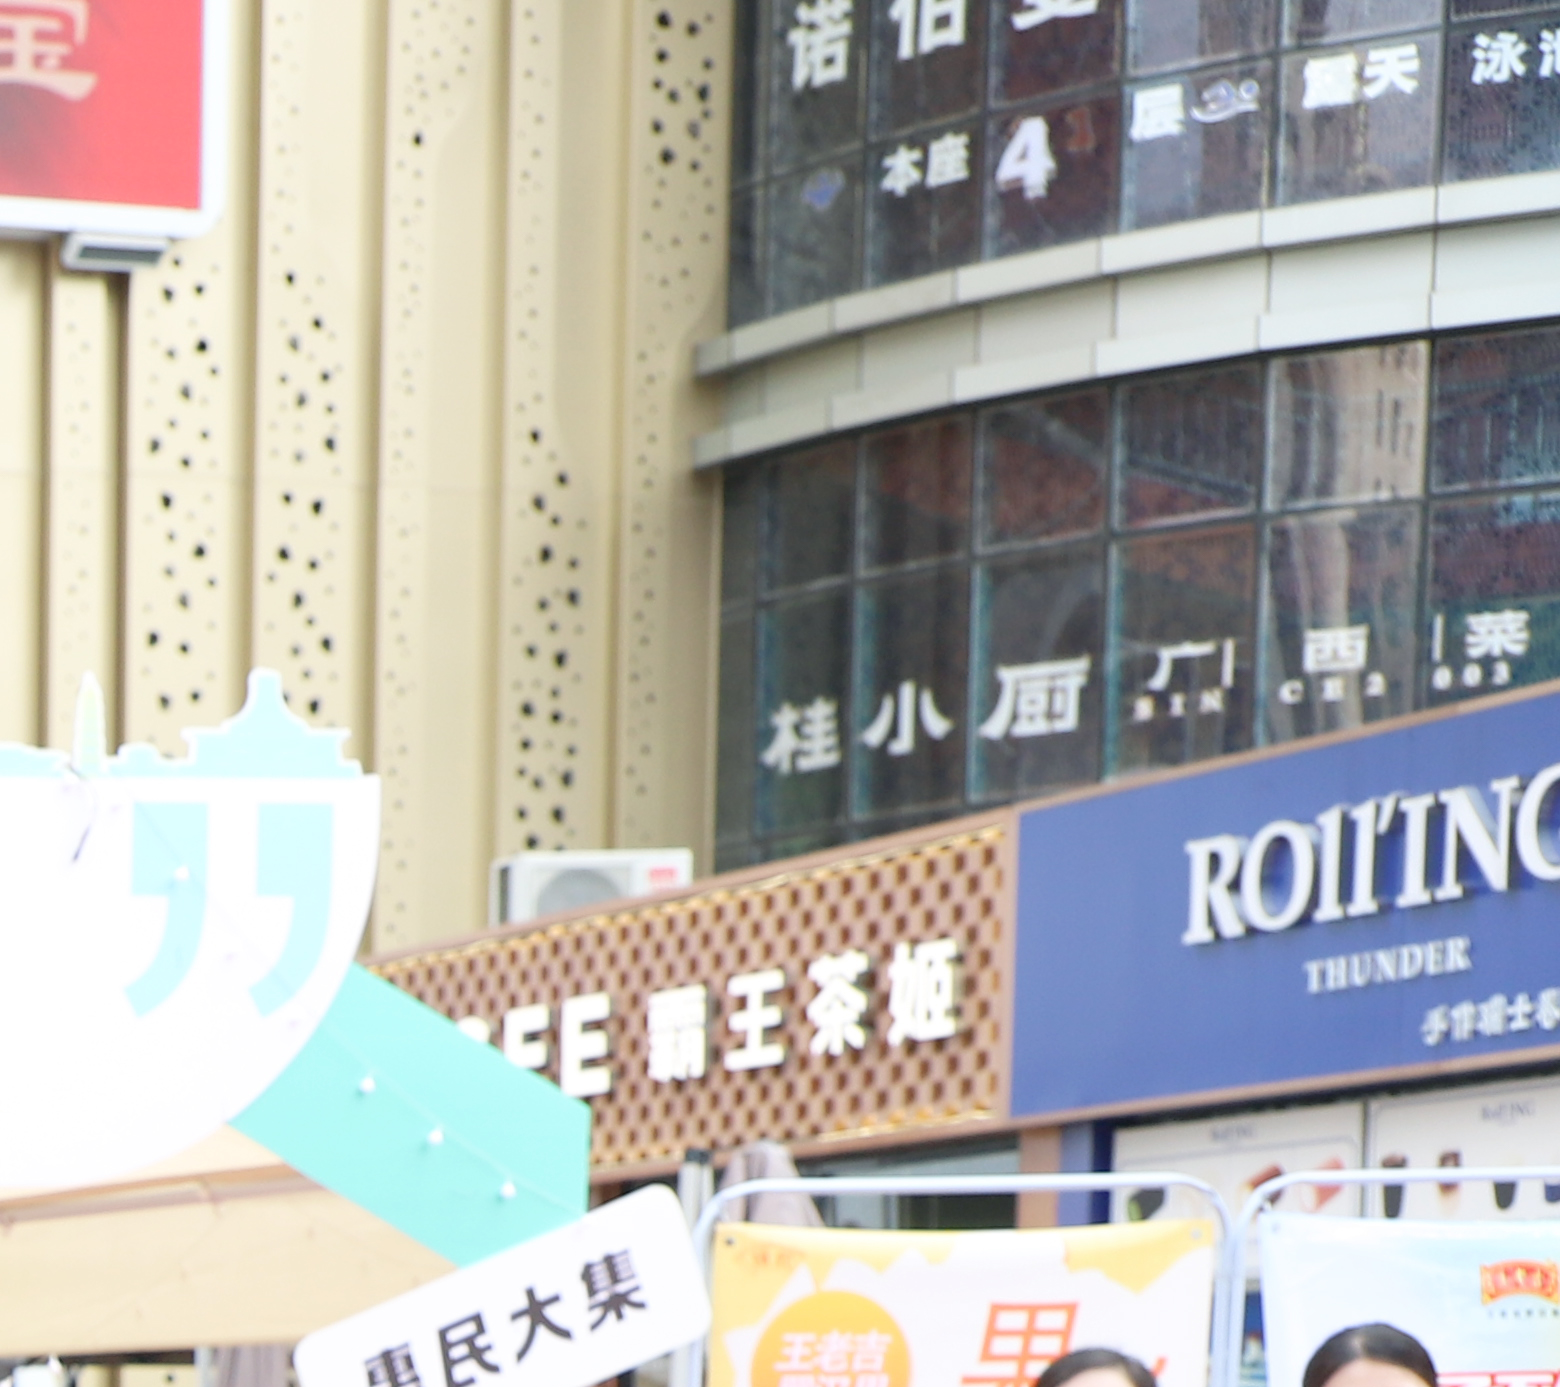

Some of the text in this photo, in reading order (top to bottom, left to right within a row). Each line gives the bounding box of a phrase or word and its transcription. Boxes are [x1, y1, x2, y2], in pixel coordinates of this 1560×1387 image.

[1304, 936, 1472, 993] THUNDER
[648, 937, 959, 1083] 霸王茶姬
[774, 1329, 891, 1374] 王老吉
